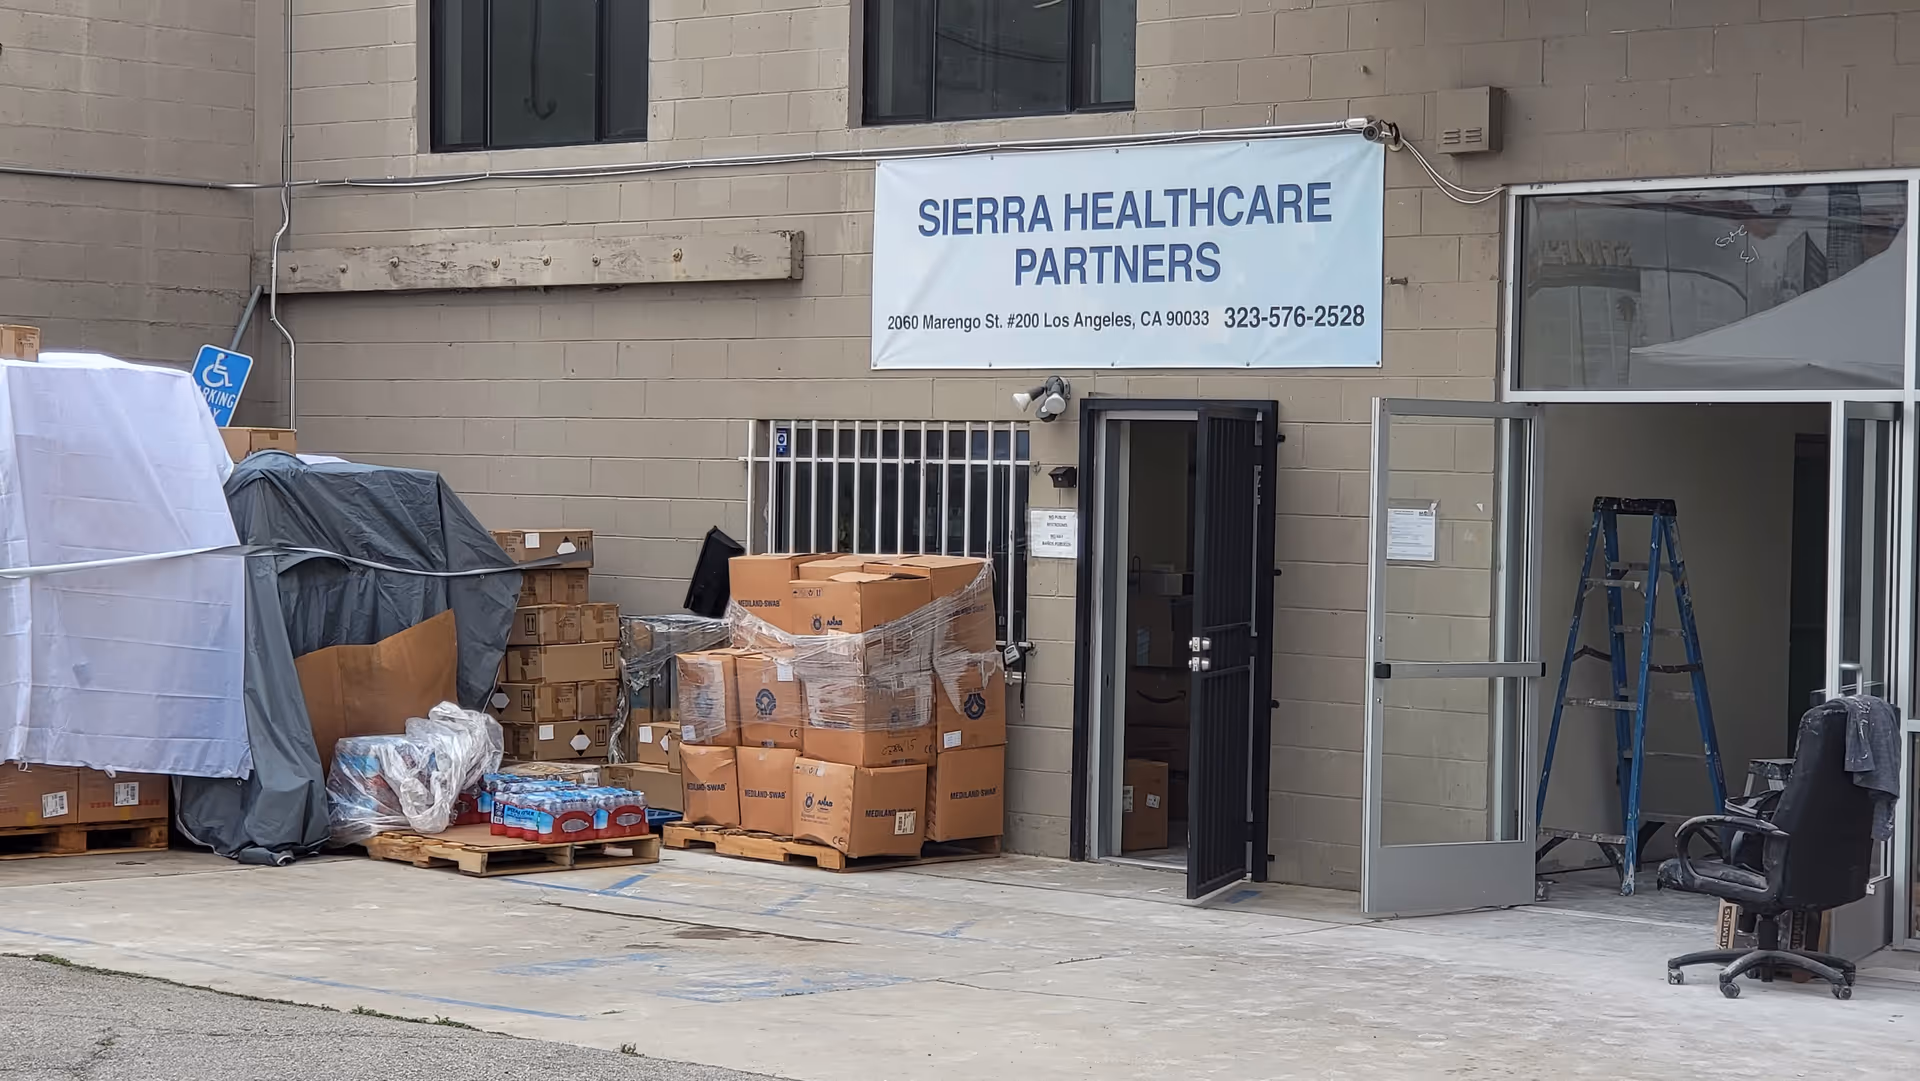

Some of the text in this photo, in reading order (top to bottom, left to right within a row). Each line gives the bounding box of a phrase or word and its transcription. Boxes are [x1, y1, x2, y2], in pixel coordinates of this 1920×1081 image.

[918, 182, 1332, 237] SIERRA HEALTHCARE
[1015, 242, 1221, 286] PARTNERS
[887, 305, 1365, 333] 2060 Marengo St. #200 Los Angeles, CA 90033 323-576-2528
[201, 386, 236, 409] RKING
